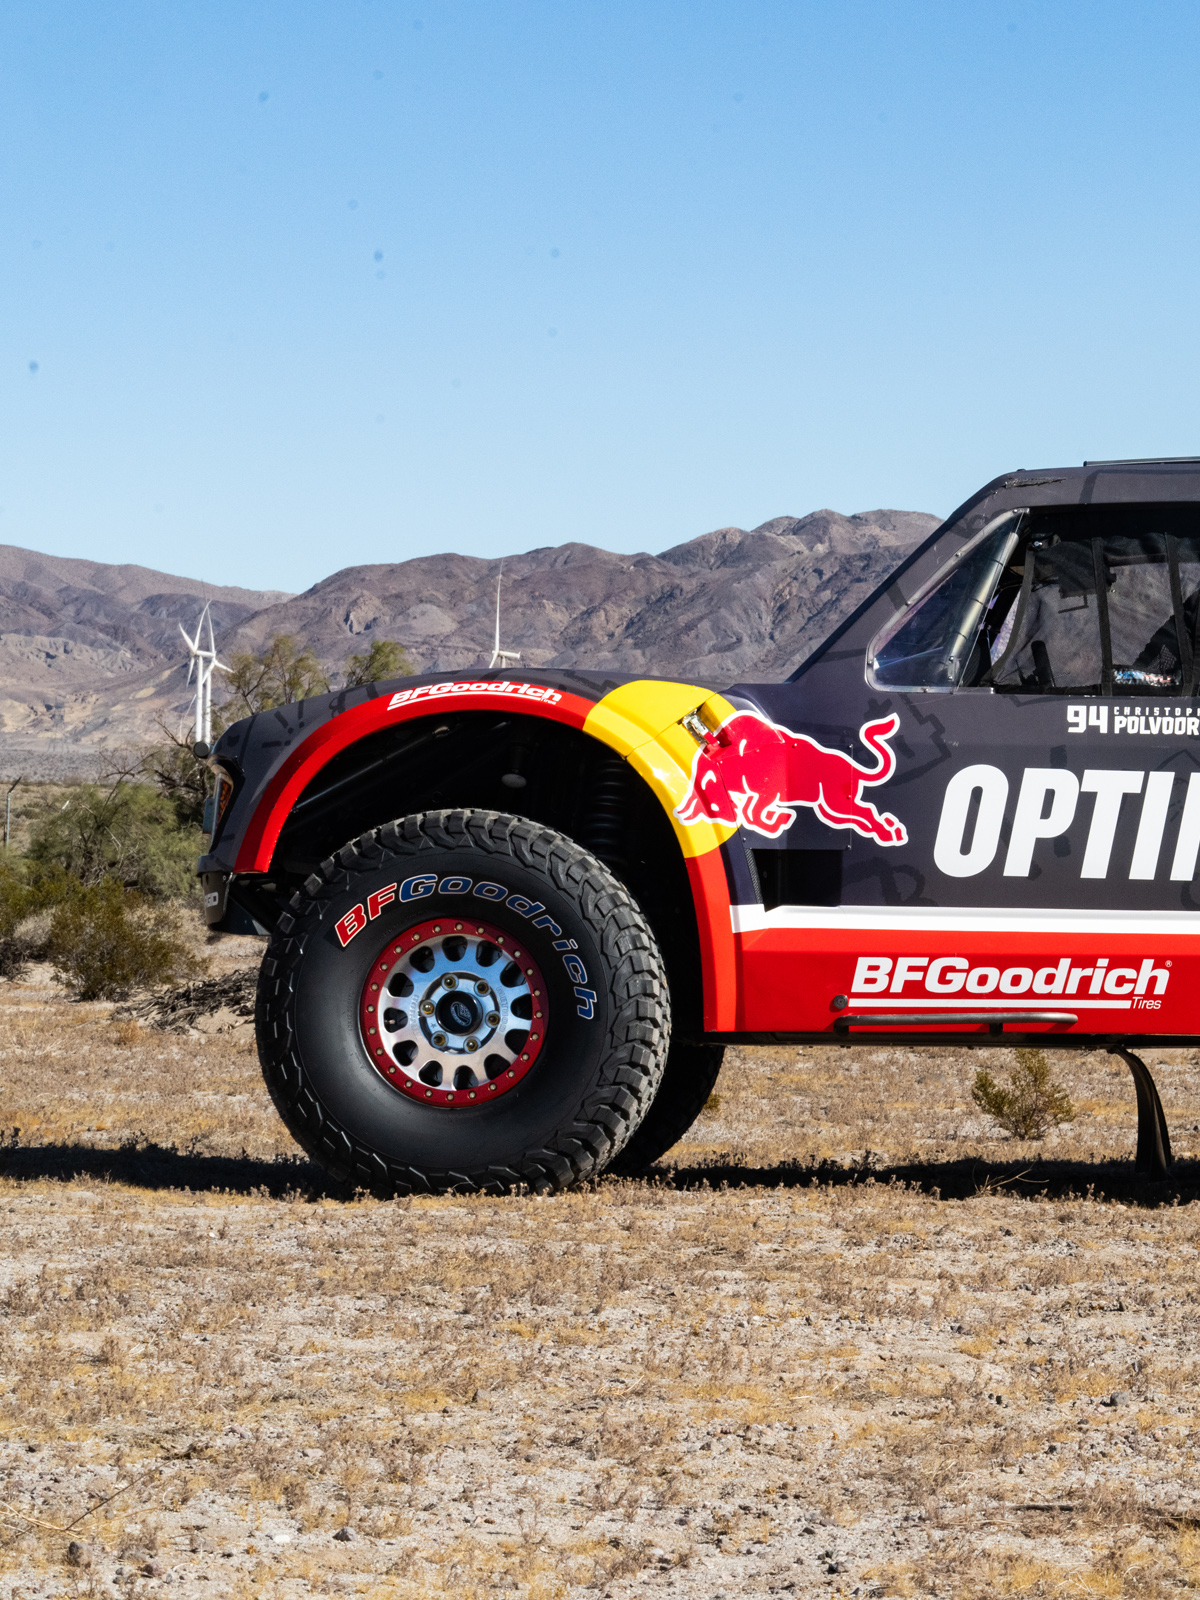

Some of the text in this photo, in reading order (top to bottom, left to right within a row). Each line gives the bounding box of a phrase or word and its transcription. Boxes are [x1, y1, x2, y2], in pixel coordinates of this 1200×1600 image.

[389, 681, 562, 706] BFGoodrich
[1067, 705, 1109, 733] 94
[335, 873, 597, 1020] BFGoodrich
[1132, 997, 1162, 1010] Tires
